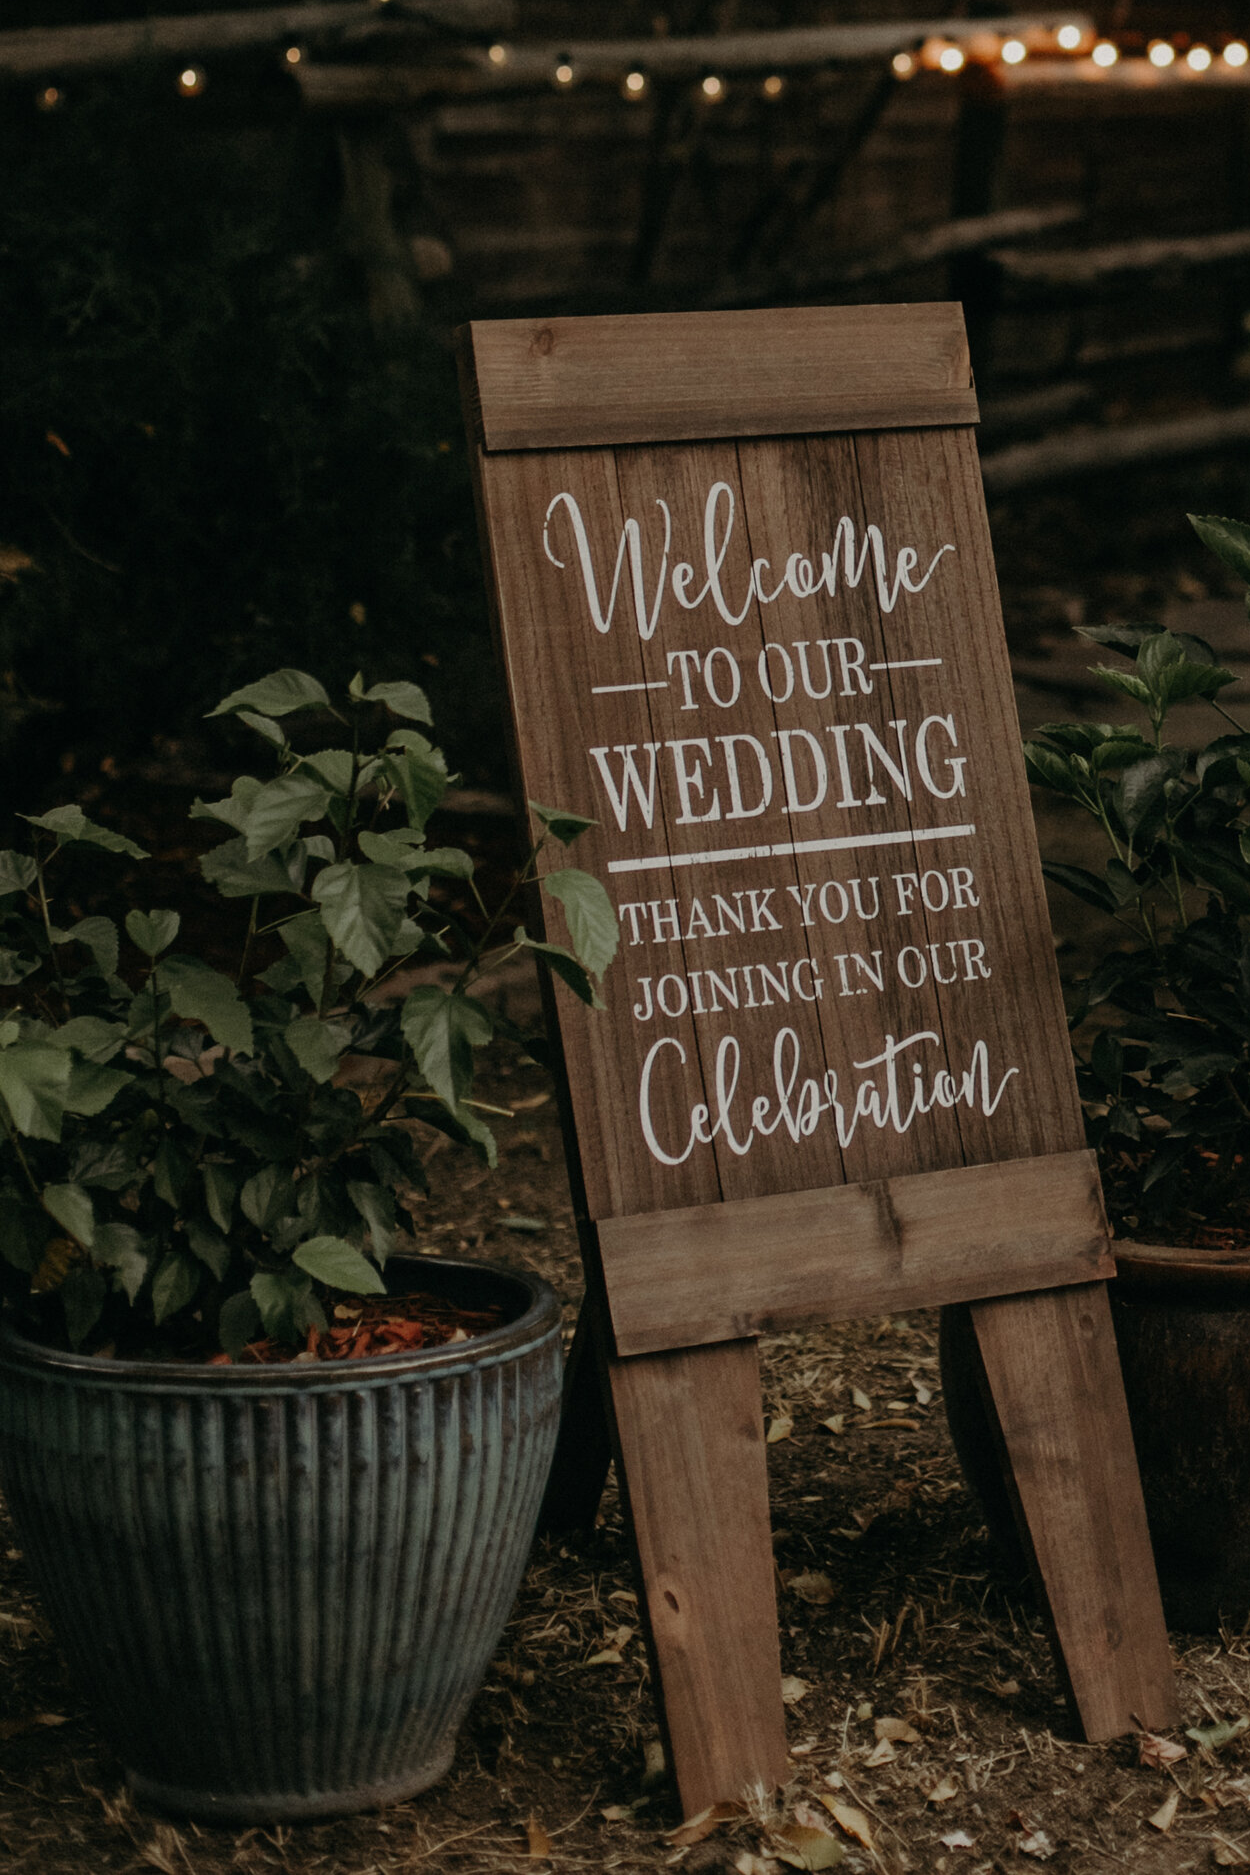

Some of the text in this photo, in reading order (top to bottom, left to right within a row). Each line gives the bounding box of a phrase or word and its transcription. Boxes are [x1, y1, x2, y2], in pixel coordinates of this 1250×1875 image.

[543, 482, 956, 640] Welcome
[667, 637, 873, 711] TO OUR
[590, 714, 967, 832] WEDDING
[619, 866, 980, 946] THANK YOU FOR
[633, 939, 991, 1021] JOINING IN OUR
[640, 1027, 1019, 1165] Celebration
